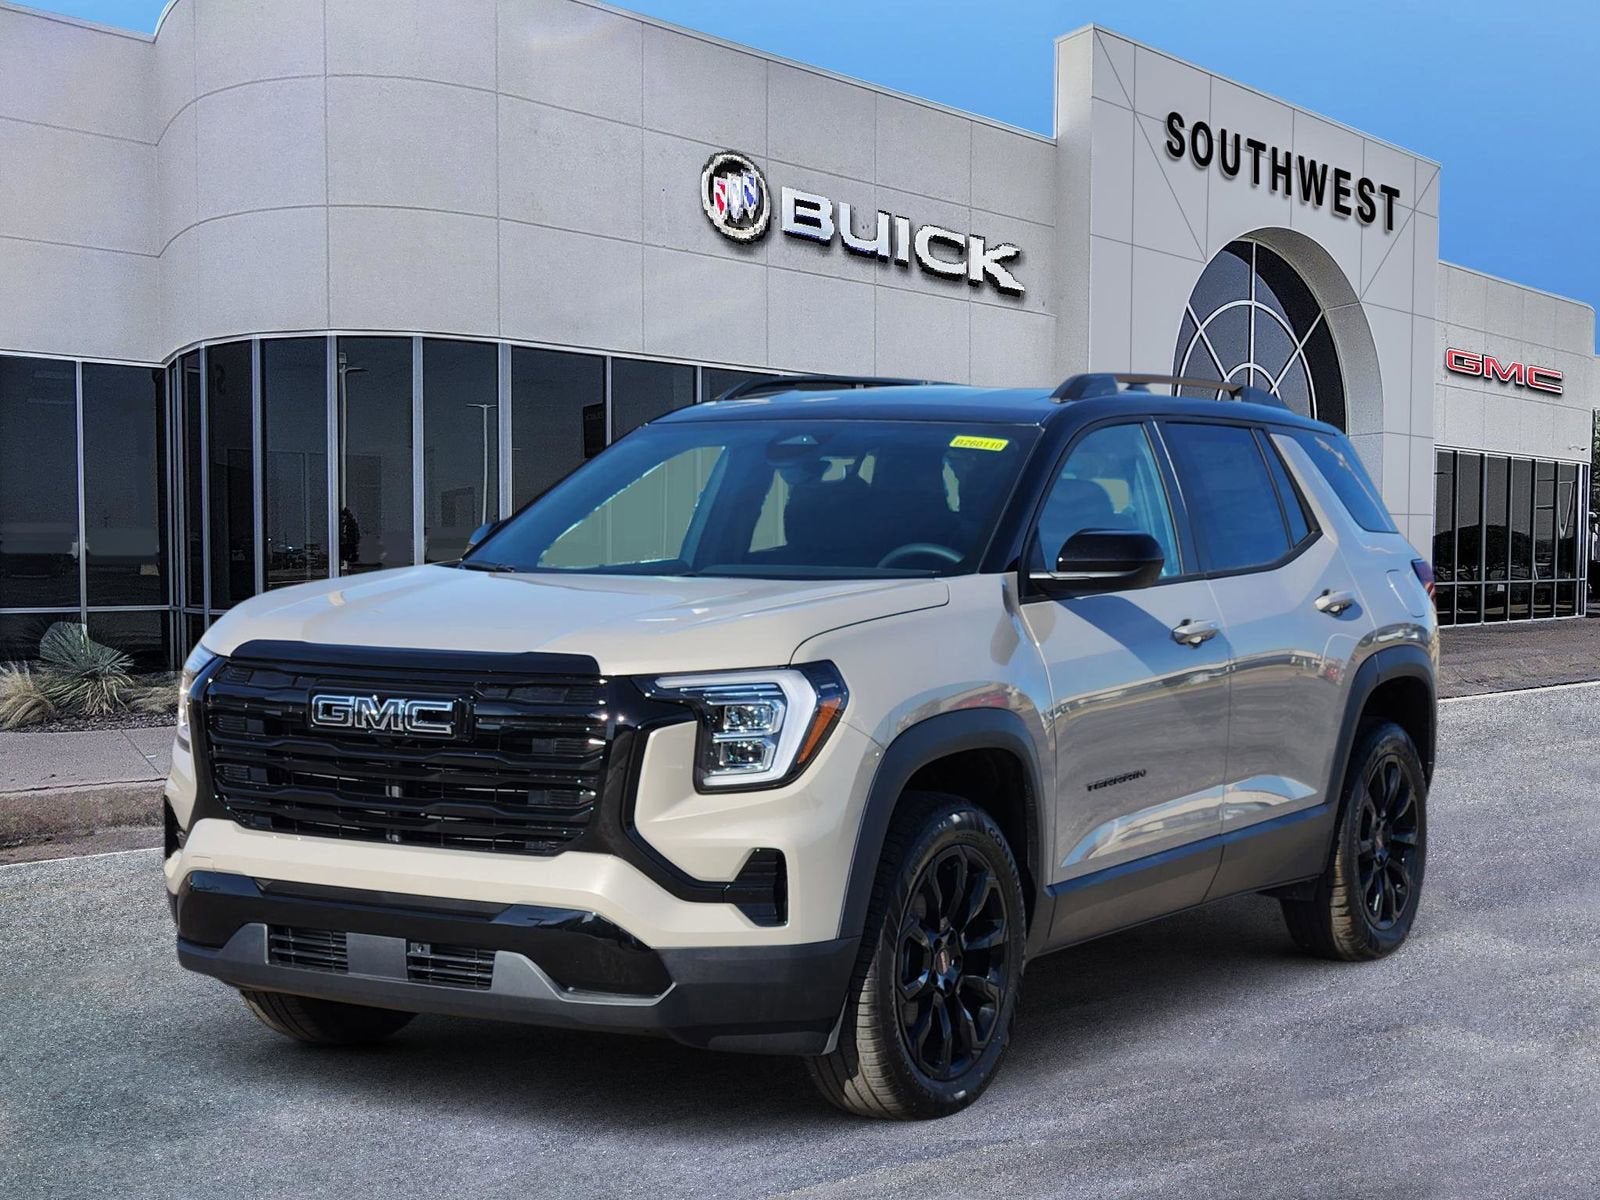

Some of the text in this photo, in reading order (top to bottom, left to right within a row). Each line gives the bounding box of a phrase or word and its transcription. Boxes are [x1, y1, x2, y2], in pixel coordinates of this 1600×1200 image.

[1166, 111, 1400, 231] SOUTHWEST
[782, 187, 1025, 295] BUICK
[1446, 347, 1563, 394] GMC
[312, 693, 454, 735] GMC
[1086, 769, 1146, 792] TERRAIN
